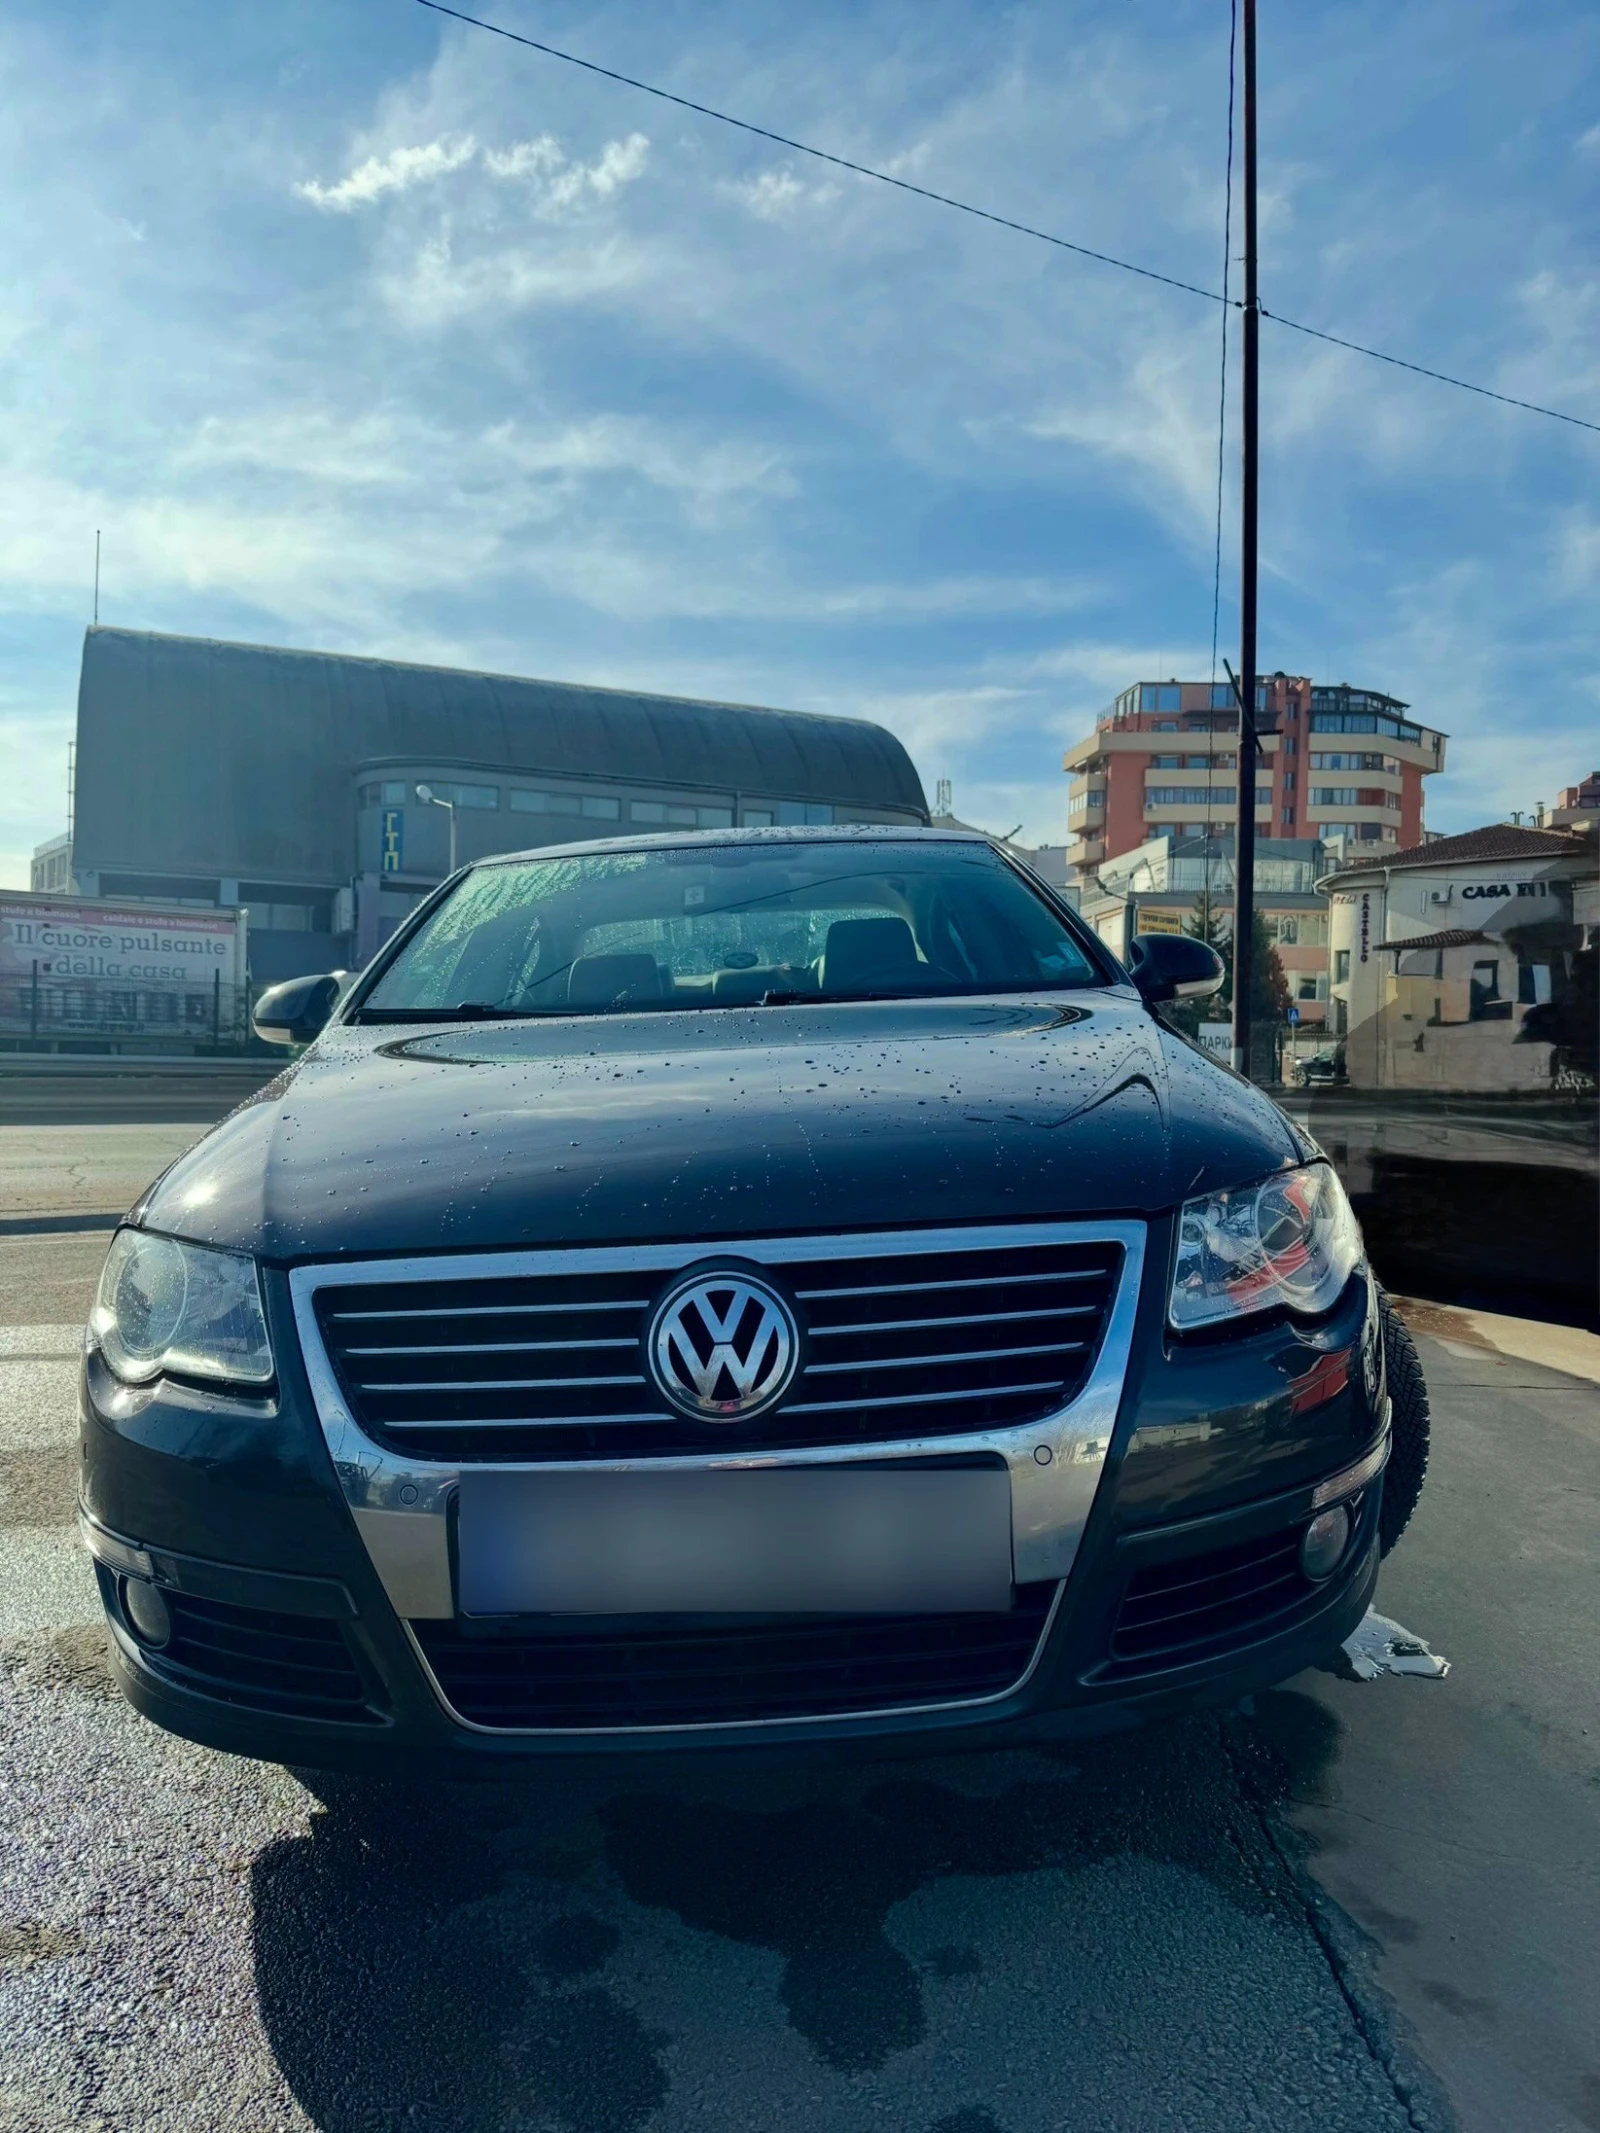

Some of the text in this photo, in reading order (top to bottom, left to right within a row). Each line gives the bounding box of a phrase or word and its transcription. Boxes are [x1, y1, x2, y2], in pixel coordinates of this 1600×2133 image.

[1462, 883, 1511, 900] CASA
[0, 906, 26, 915] stufe
[35, 907, 81, 919] biomasse
[103, 913, 136, 924] caldaie
[145, 917, 168, 926] stufe
[176, 918, 218, 930] biomasse
[15, 924, 227, 956] Il cuore pulsante
[1361, 893, 1370, 963] CASTELLO
[56, 955, 188, 979] della casa
[658, 1279, 789, 1413] VW
